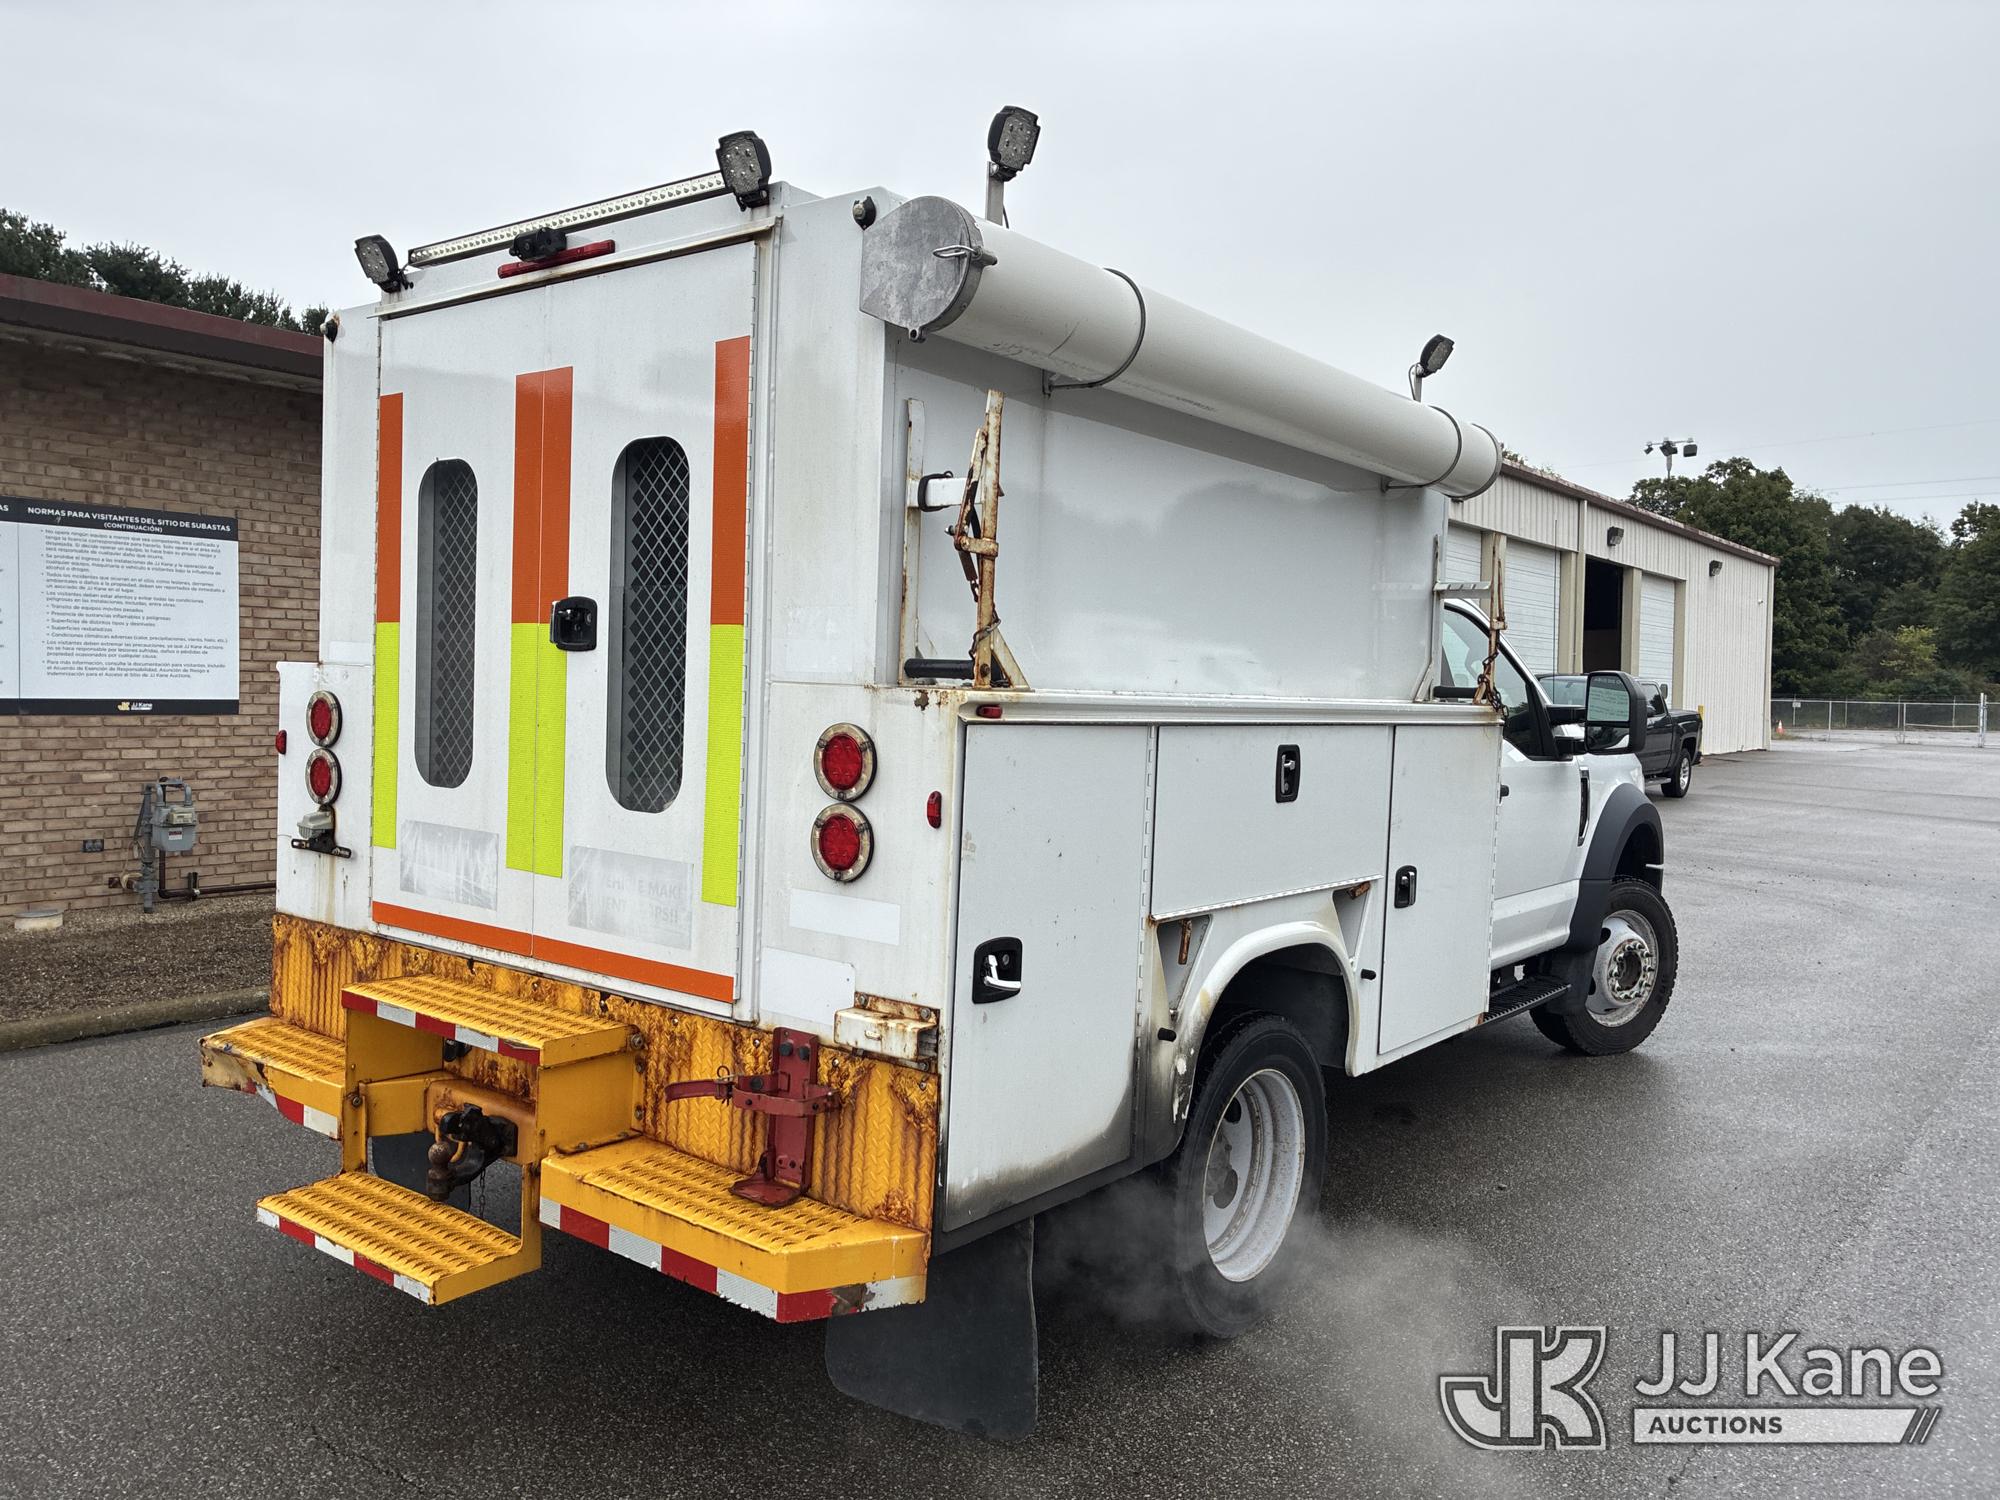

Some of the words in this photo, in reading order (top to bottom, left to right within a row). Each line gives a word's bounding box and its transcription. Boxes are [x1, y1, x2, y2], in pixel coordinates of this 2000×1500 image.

[28, 507, 66, 516] NORMAS
[67, 510, 90, 518] PARA
[92, 512, 139, 523] VISITANTES
[191, 522, 231, 531] SUBASTAS
[104, 522, 163, 532] (CONTINUACIÓN)
